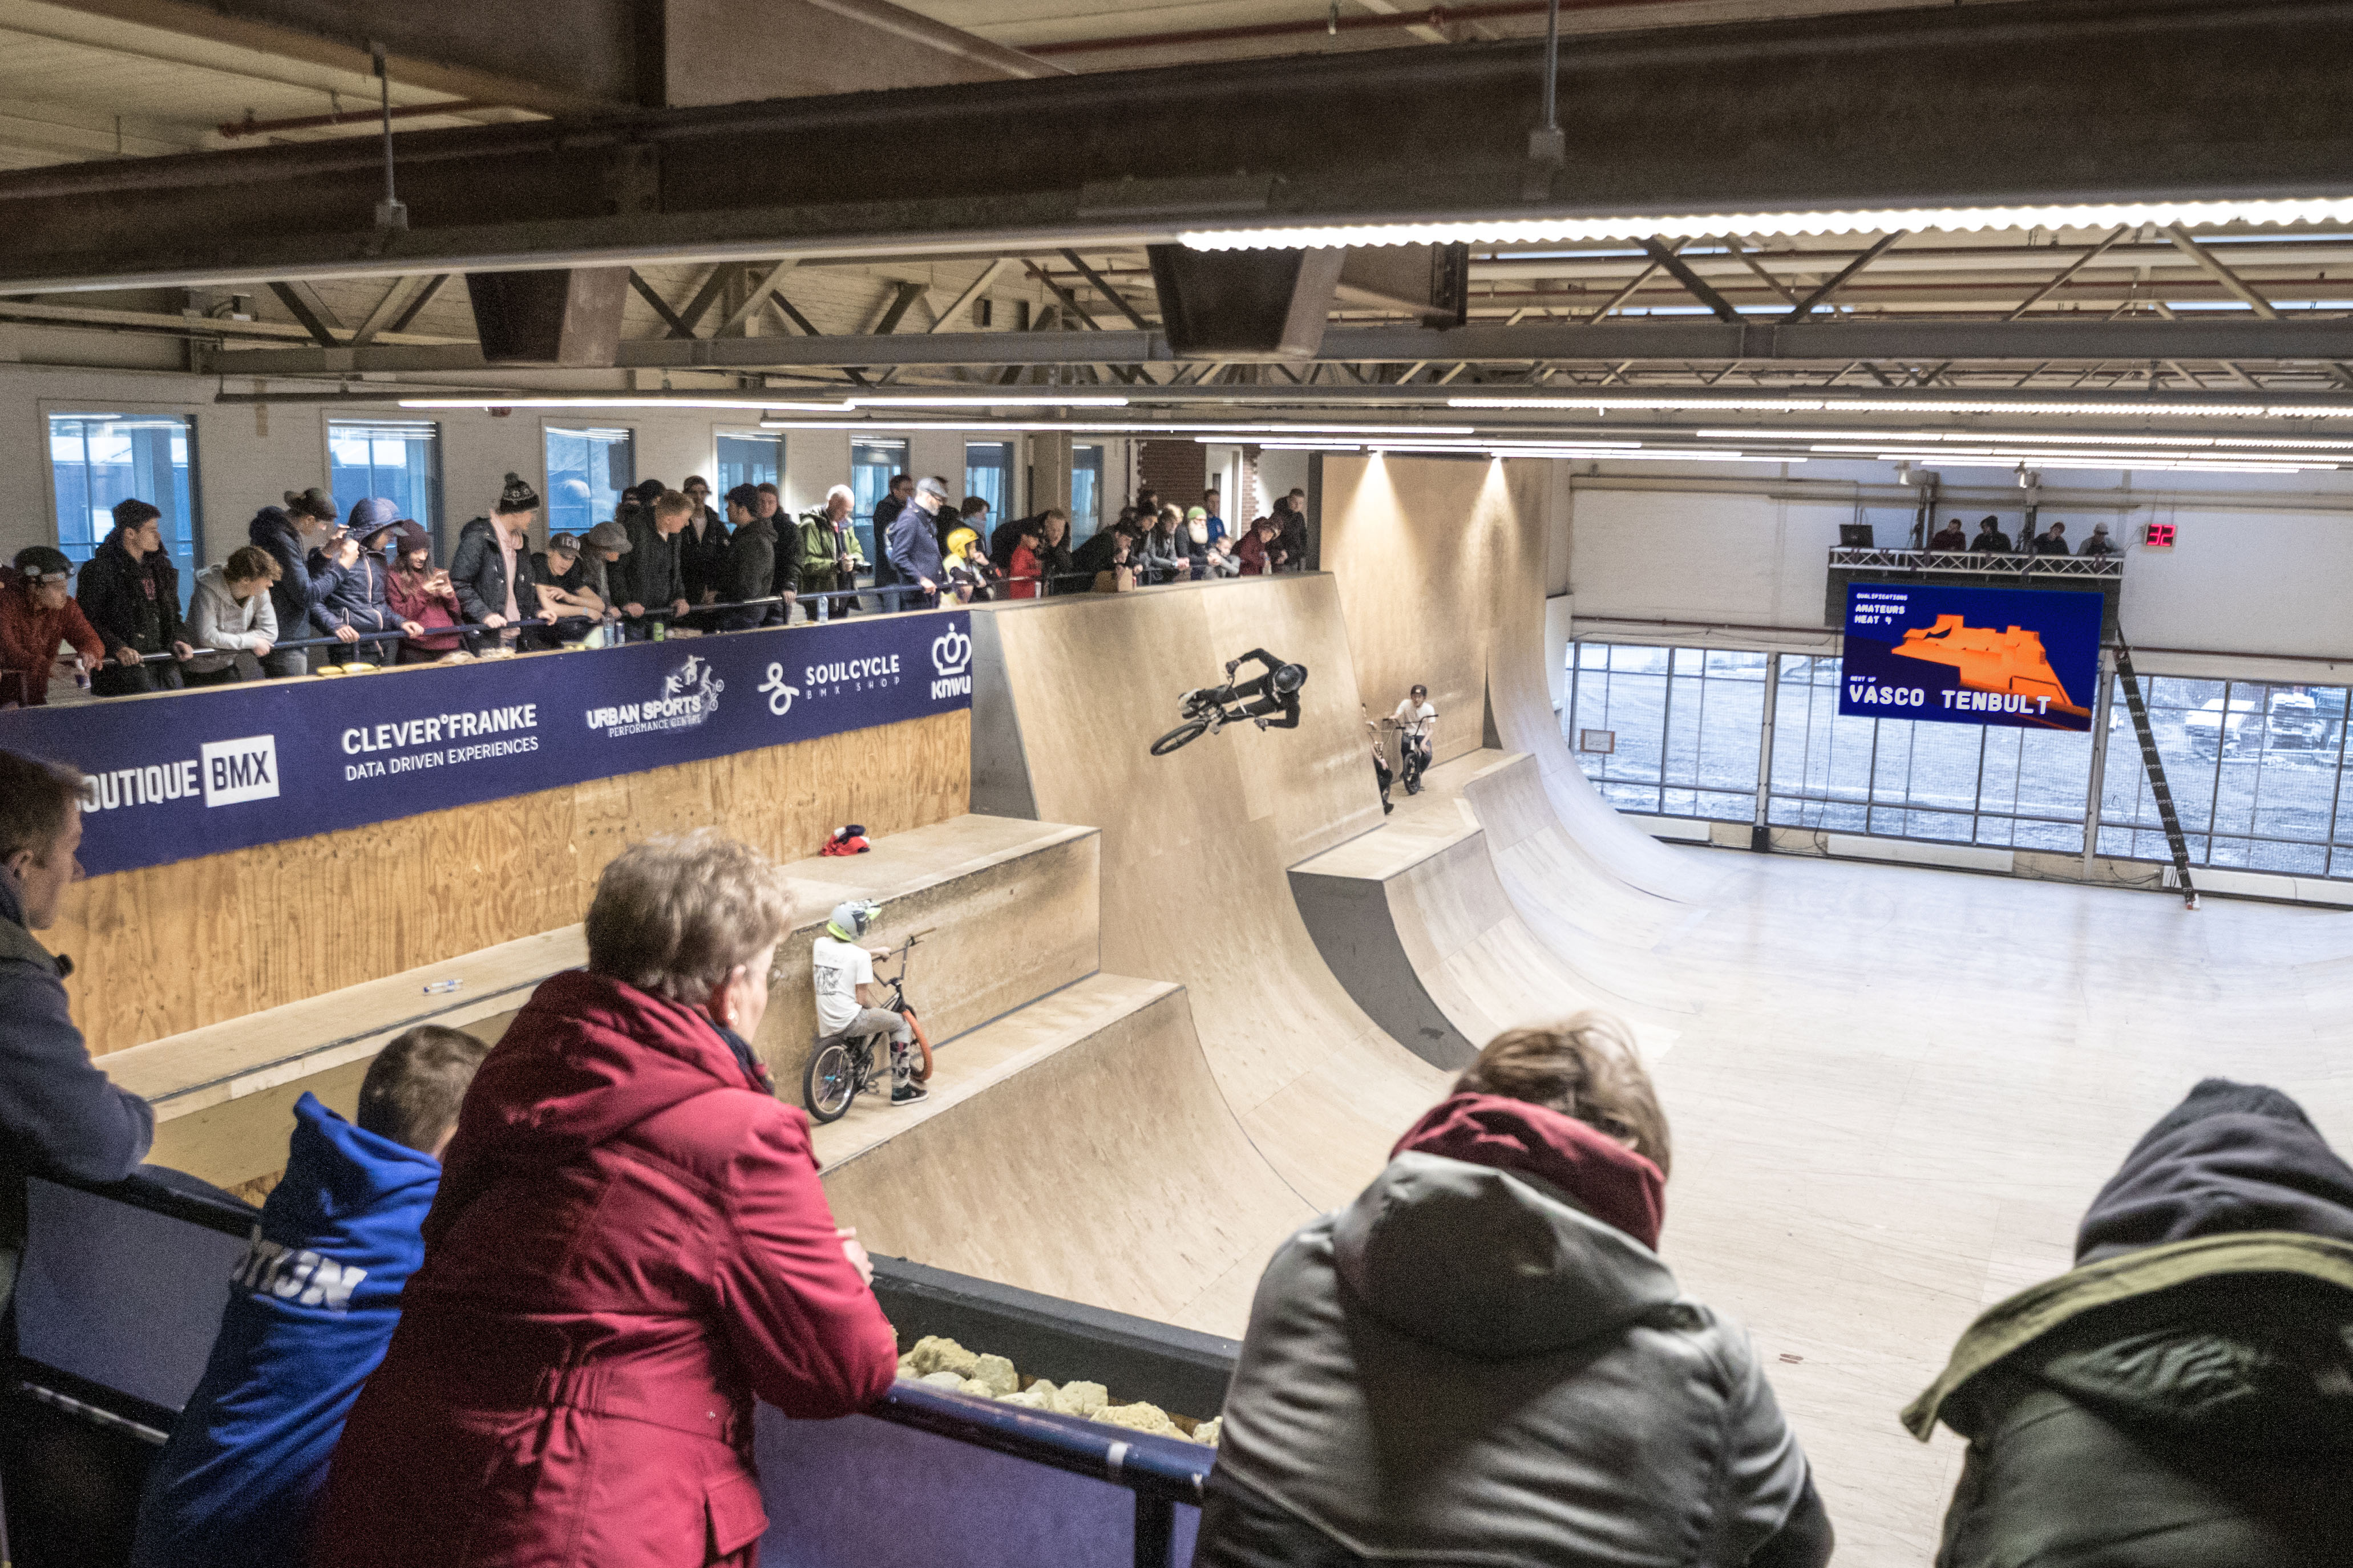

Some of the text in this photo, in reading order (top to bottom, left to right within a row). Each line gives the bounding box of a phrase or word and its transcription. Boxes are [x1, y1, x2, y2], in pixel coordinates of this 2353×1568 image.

[2147, 524, 2176, 546] 32
[1854, 615, 1879, 625] HEAT
[1855, 604, 1905, 614] AMATEURS
[806, 654, 900, 686] SOULCYCLE
[806, 676, 900, 699] BMX SHOP
[1849, 684, 1925, 707] VASCO
[587, 695, 702, 730] URBAN SPORTS
[609, 714, 702, 738] PERFORMANCE CENTRE
[345, 735, 539, 781] DATA DRIVEN EXPERIENCES
[76, 750, 271, 813] OUTIQUE BMX
